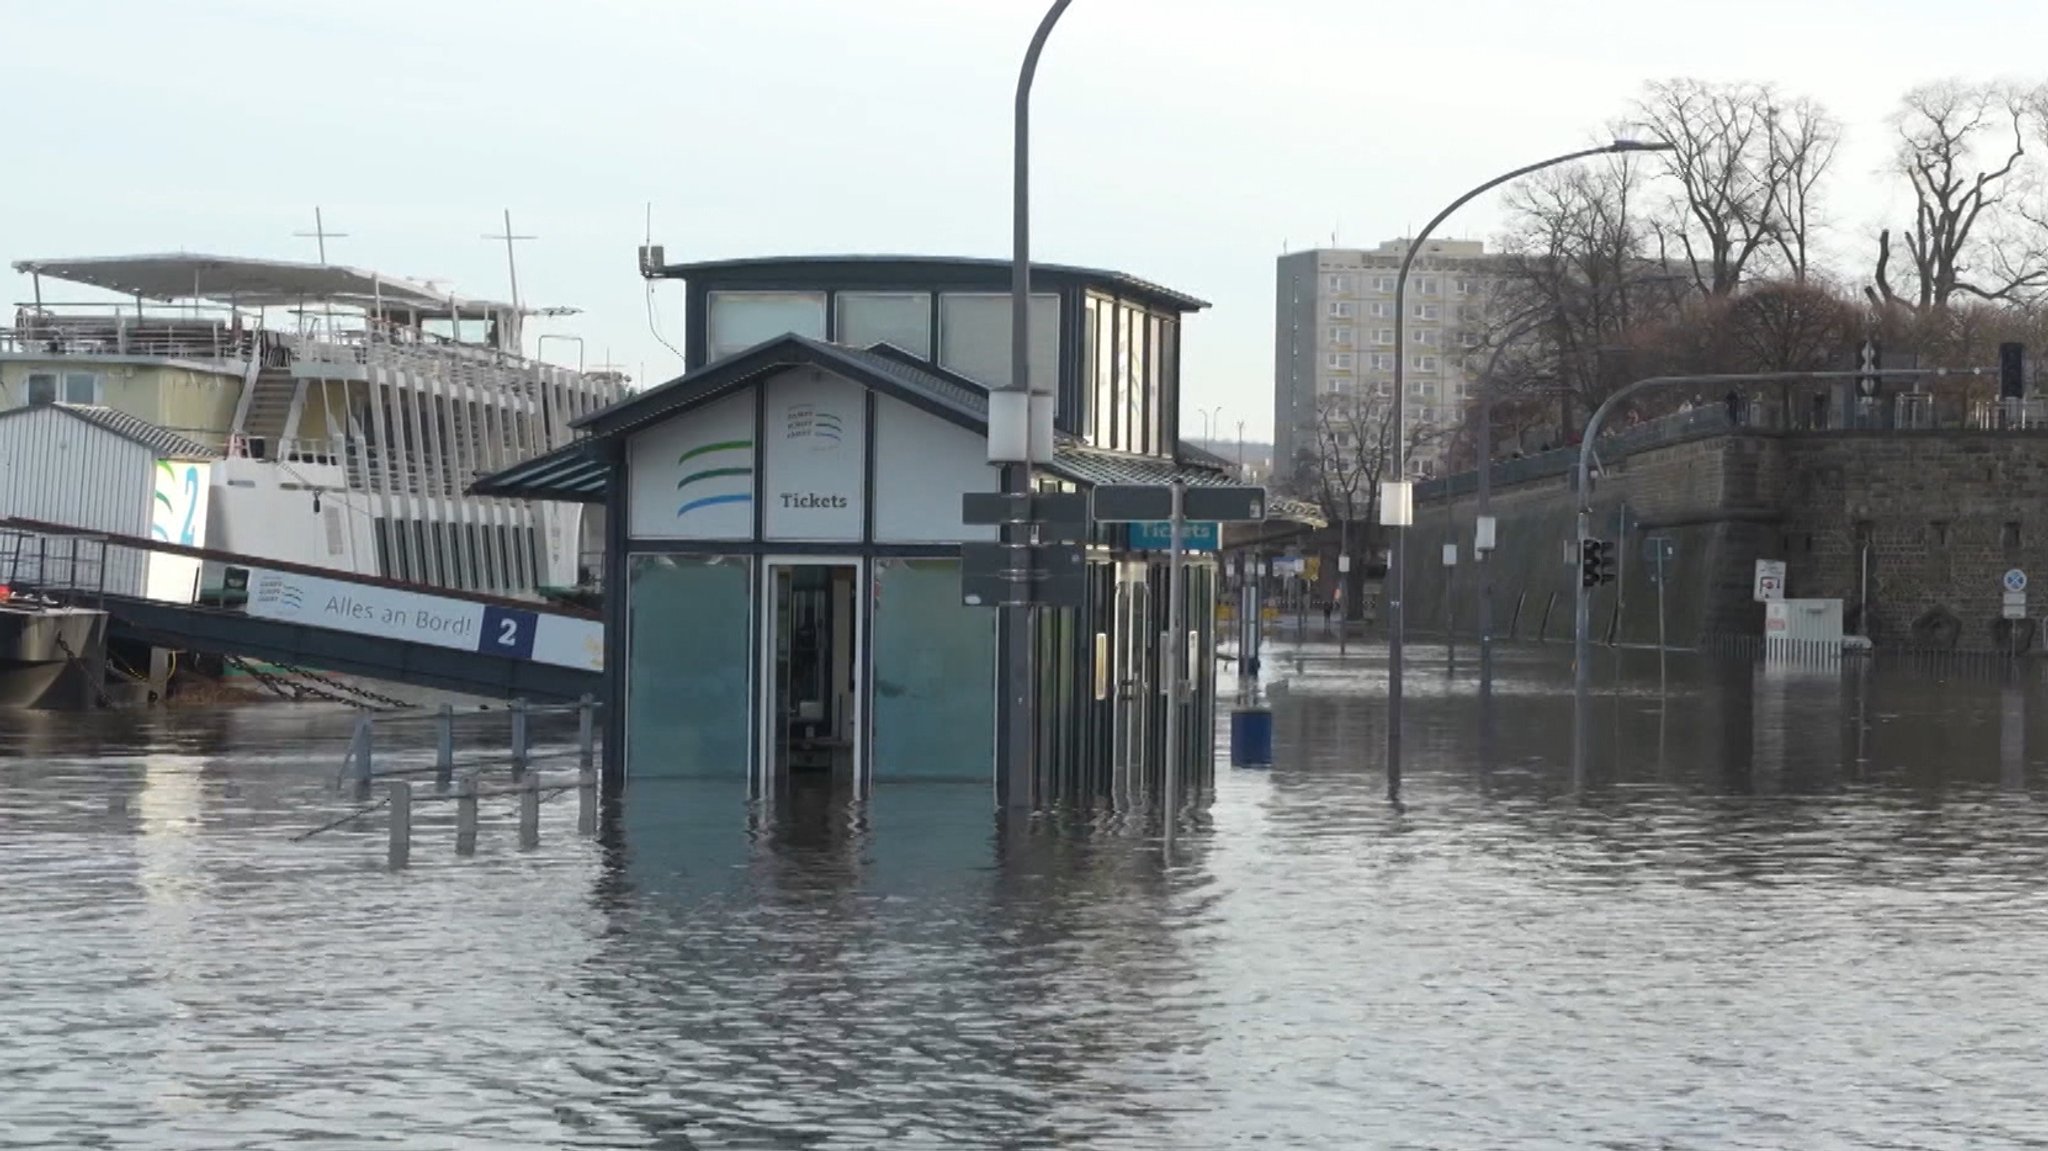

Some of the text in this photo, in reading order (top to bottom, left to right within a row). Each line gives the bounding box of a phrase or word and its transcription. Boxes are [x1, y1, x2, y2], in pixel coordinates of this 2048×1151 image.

[780, 492, 848, 509] Tickets
[1141, 521, 1211, 538] Ticets
[324, 595, 472, 636] Alles an Bord!
[497, 618, 518, 647] 2
